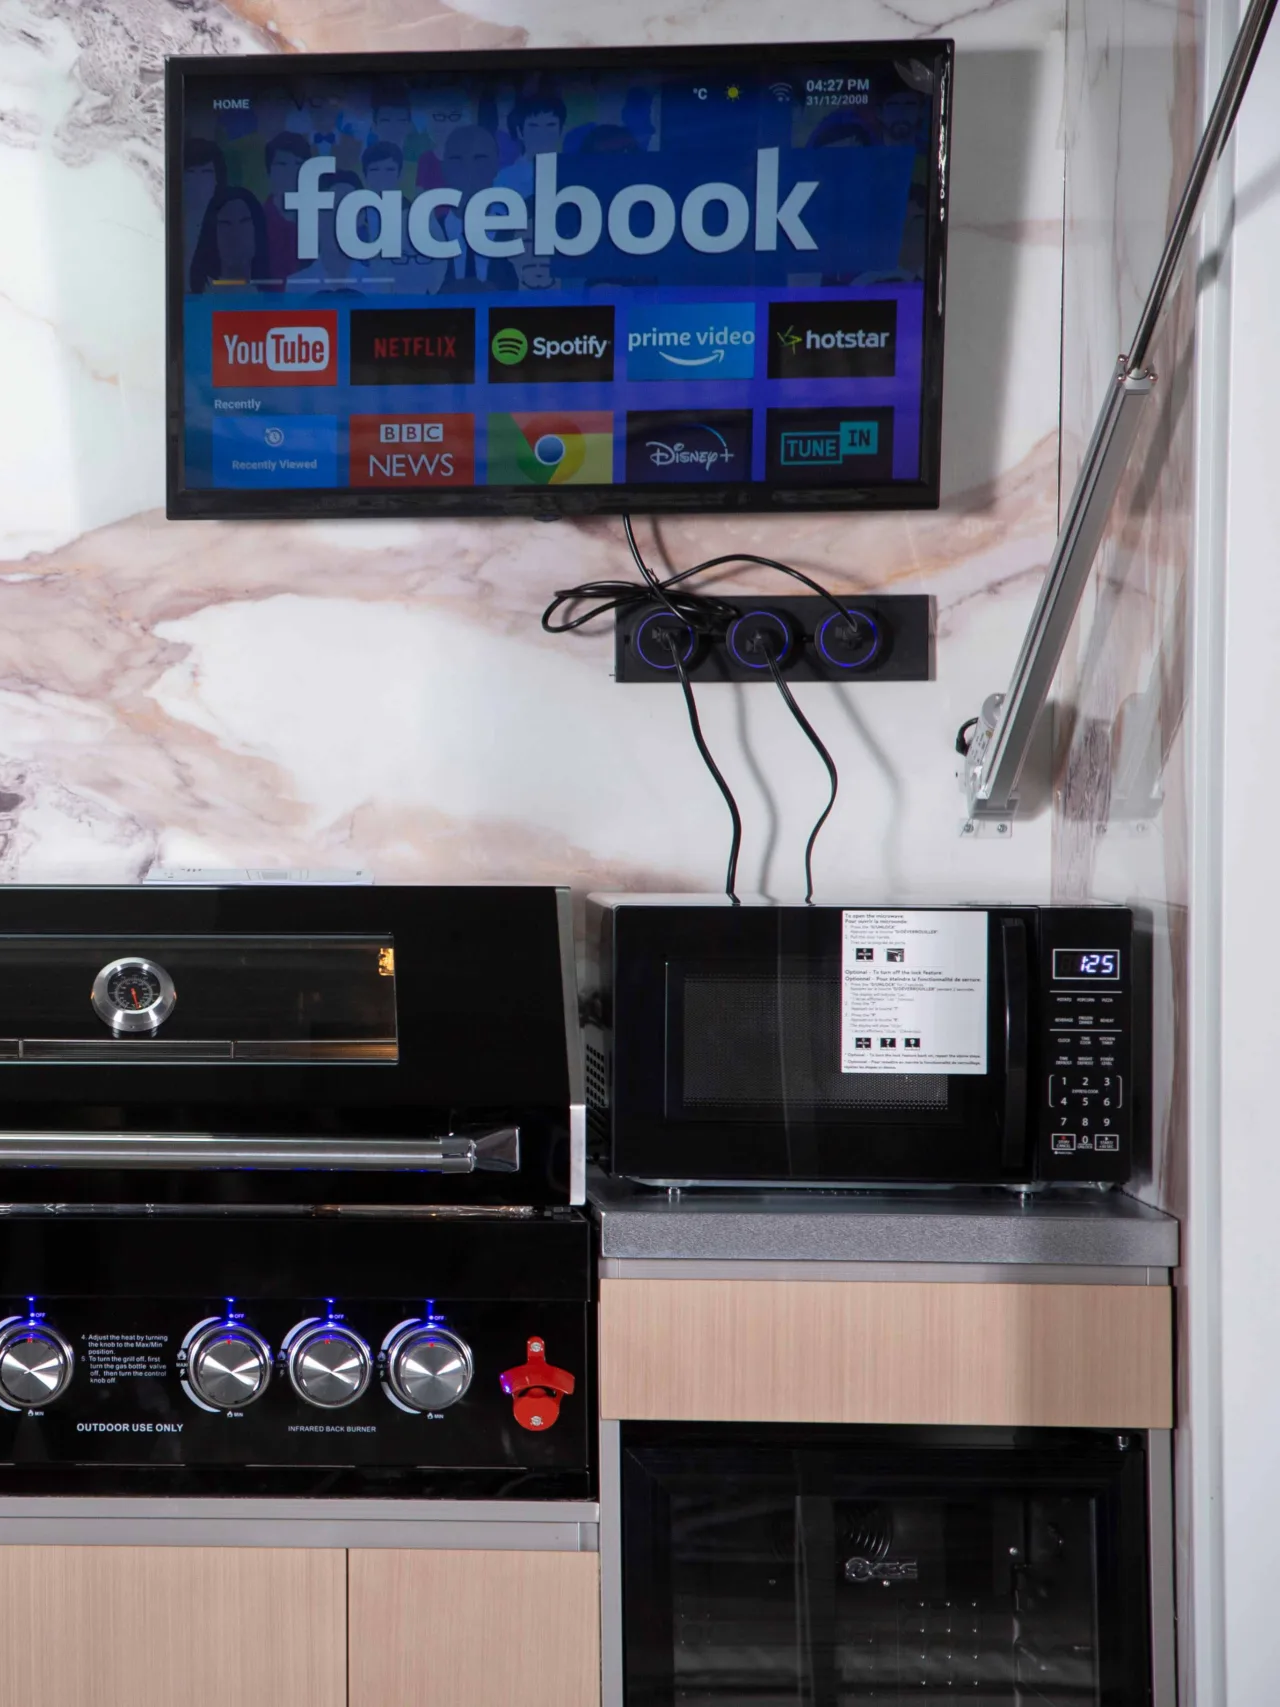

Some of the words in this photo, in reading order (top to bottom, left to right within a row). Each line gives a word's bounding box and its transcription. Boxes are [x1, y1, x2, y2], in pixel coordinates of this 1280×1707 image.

[806, 79, 844, 92] 04:27
[848, 79, 869, 91] PM
[213, 99, 250, 109] HOME
[806, 94, 868, 106] 31/12/2008
[284, 146, 820, 260] facebook
[628, 328, 691, 351] prime
[696, 326, 755, 346] video
[806, 328, 889, 349] hotstar
[224, 331, 326, 367] YouTube
[374, 336, 456, 358] NETFLIX
[532, 334, 608, 359] Spotify
[214, 398, 261, 411] Recently
[380, 423, 443, 443] BBC
[786, 438, 837, 458] TUNE
[847, 429, 870, 446] IN
[232, 459, 276, 471] Recently
[279, 458, 317, 469] Viewed
[369, 452, 454, 477] NEWS
[1081, 955, 1114, 973] 1:25
[1062, 1077, 1066, 1085] 1
[1082, 1077, 1088, 1085] 2
[1104, 1077, 1110, 1086] 3
[1061, 1097, 1067, 1105] 4
[1083, 1098, 1088, 1106] 5
[1104, 1098, 1110, 1106] 6
[1061, 1118, 1067, 1126] 7
[1082, 1118, 1088, 1126] 8
[1104, 1118, 1110, 1126] 9
[1082, 1136, 1088, 1144] 0
[77, 1423, 129, 1432] OUTDOOR
[132, 1424, 153, 1432] USE
[156, 1424, 184, 1432] ONLY
